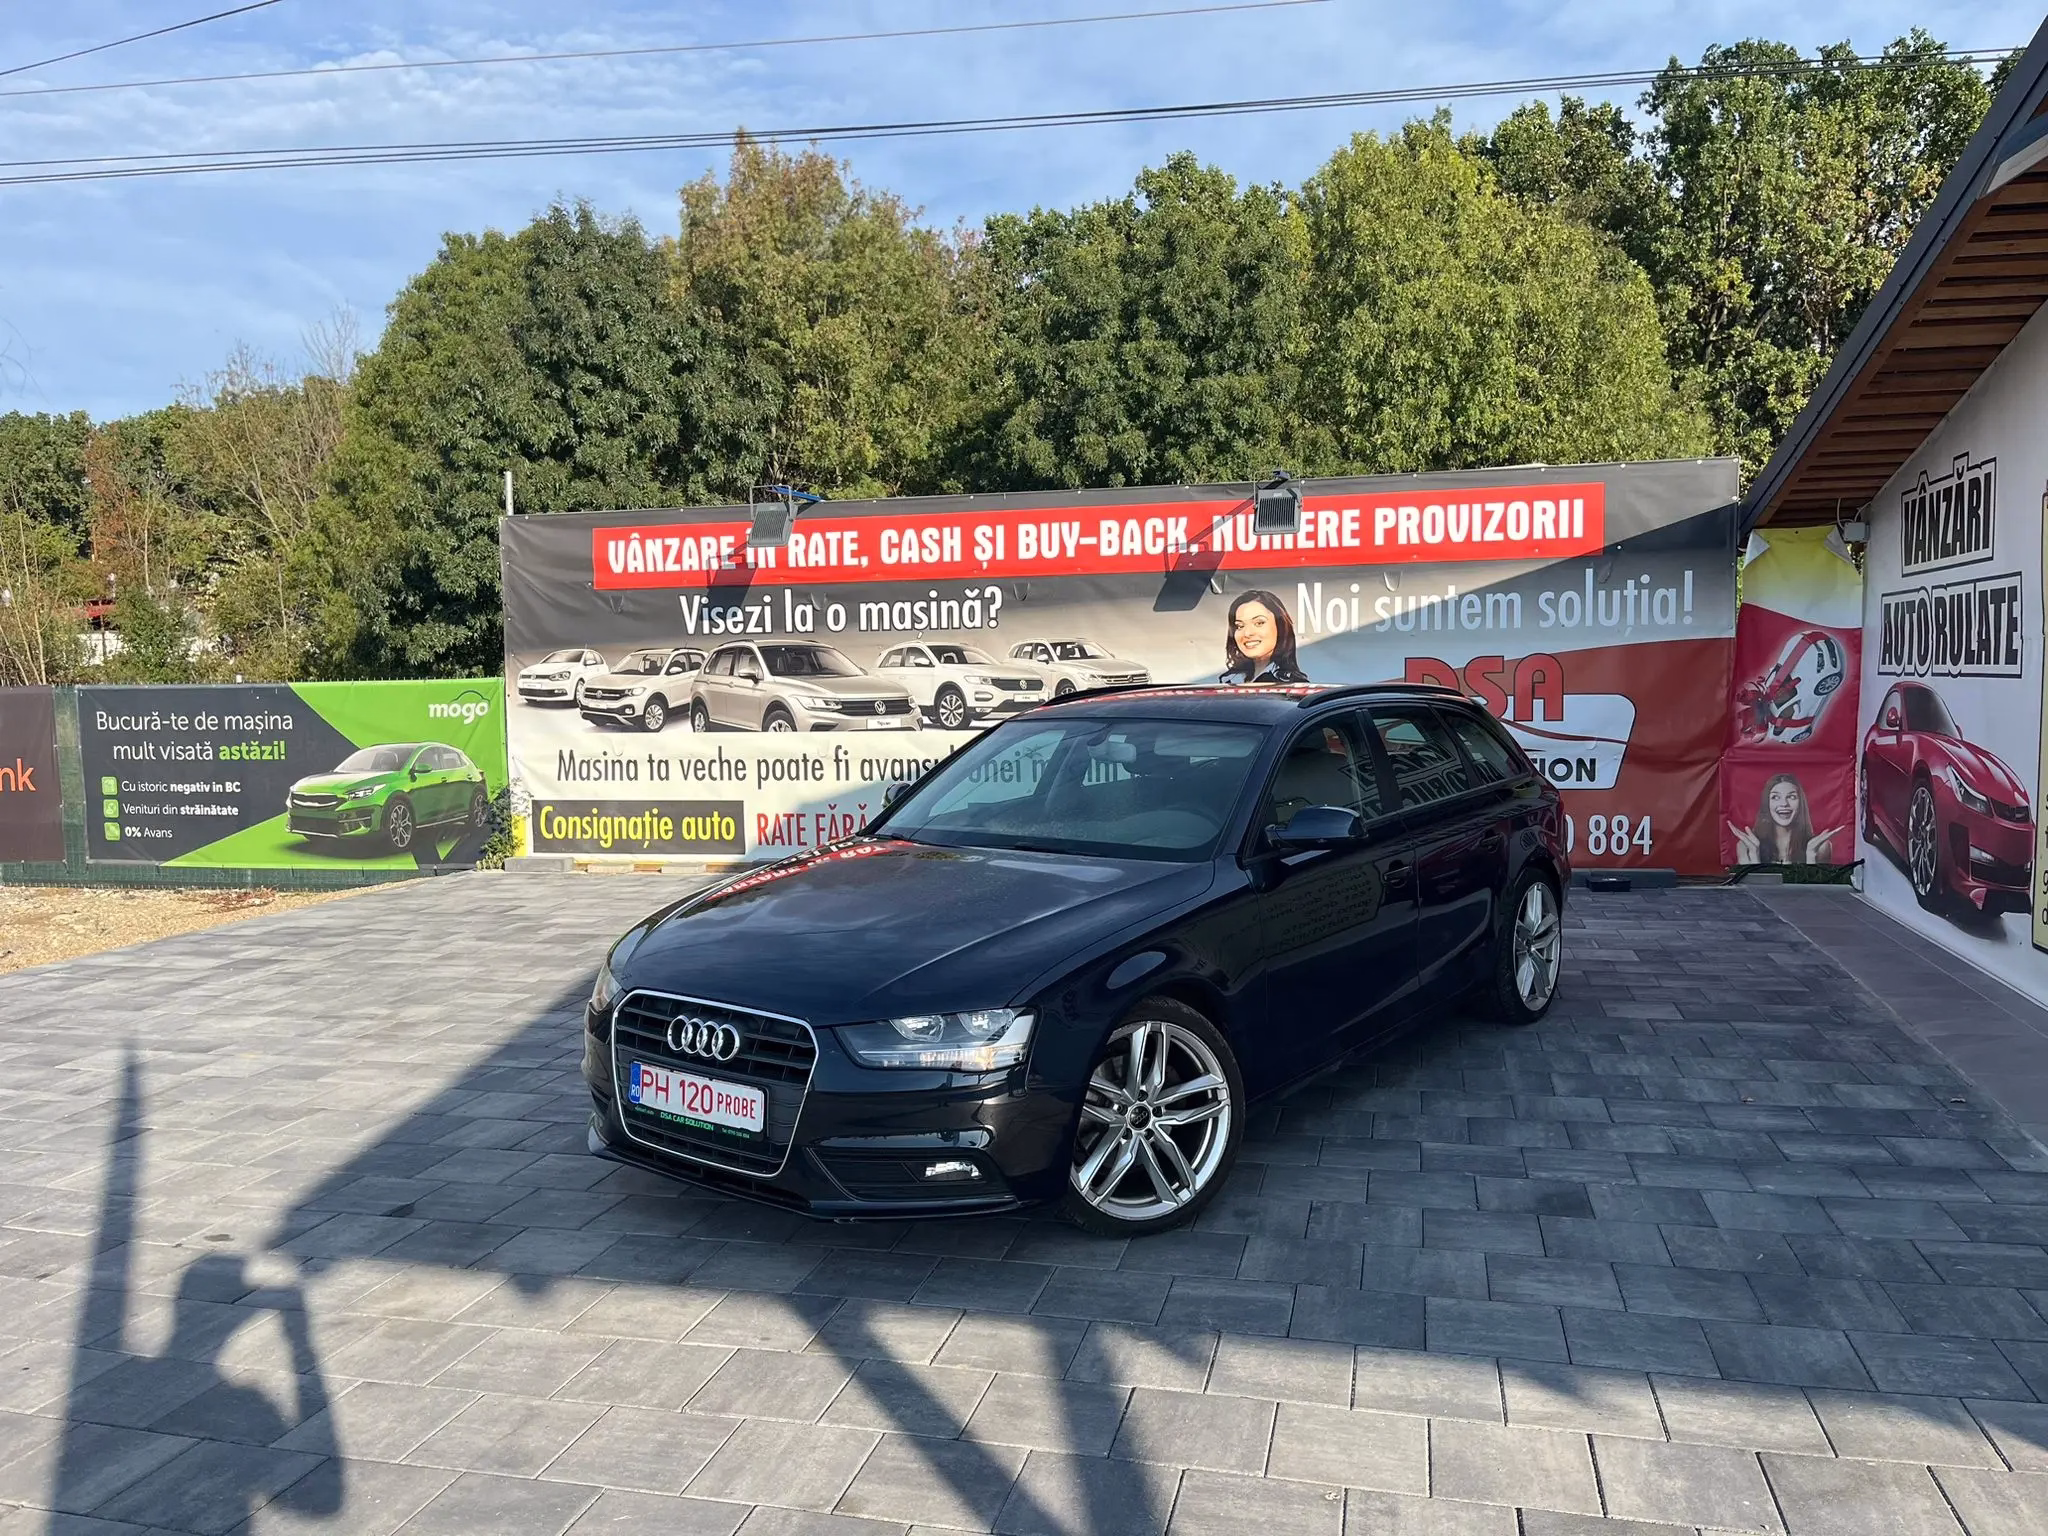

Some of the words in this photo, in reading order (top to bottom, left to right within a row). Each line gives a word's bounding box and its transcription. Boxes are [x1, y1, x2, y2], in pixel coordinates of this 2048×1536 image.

[608, 532, 736, 573] VÂNZARE
[787, 530, 869, 568] RATE,
[880, 526, 961, 564] CASH
[974, 524, 1005, 570] ȘI
[1374, 498, 1585, 546] PROVIZORII
[1904, 466, 1992, 567] VÂNZĂRI
[679, 594, 773, 635] Visezi
[784, 588, 814, 633] la
[827, 603, 848, 632] o
[1297, 582, 1359, 635] Noi
[1374, 584, 1522, 632] suntem
[1538, 568, 1694, 637] soluția!
[96, 711, 189, 731] Bucură-te
[194, 711, 219, 731] de
[224, 711, 294, 735] mașina
[428, 701, 489, 725] mogo
[113, 741, 156, 760] mult
[159, 741, 213, 761] visată
[219, 740, 287, 761] astăzi!
[557, 749, 639, 782] Masina
[648, 753, 670, 781] ta
[680, 745, 747, 782] veche
[757, 753, 825, 790] poate
[834, 744, 850, 781] fi
[860, 744, 955, 782] avans
[121, 780, 136, 792] Cu
[138, 780, 169, 792] istoric
[170, 781, 211, 795] negativ
[212, 781, 224, 793] in
[225, 781, 241, 793] BC
[123, 803, 161, 815] Venituri
[162, 803, 179, 816] din
[180, 804, 239, 816] străinătate
[540, 805, 674, 848] Consignație
[682, 810, 736, 841] auto
[124, 826, 142, 838] 0%
[144, 827, 173, 839] Avans
[758, 813, 807, 847] RATE
[1588, 814, 1653, 856] 884
[630, 1083, 640, 1098] RO
[641, 1069, 669, 1104] PH
[680, 1079, 713, 1115] 120
[716, 1092, 757, 1120] PROBE
